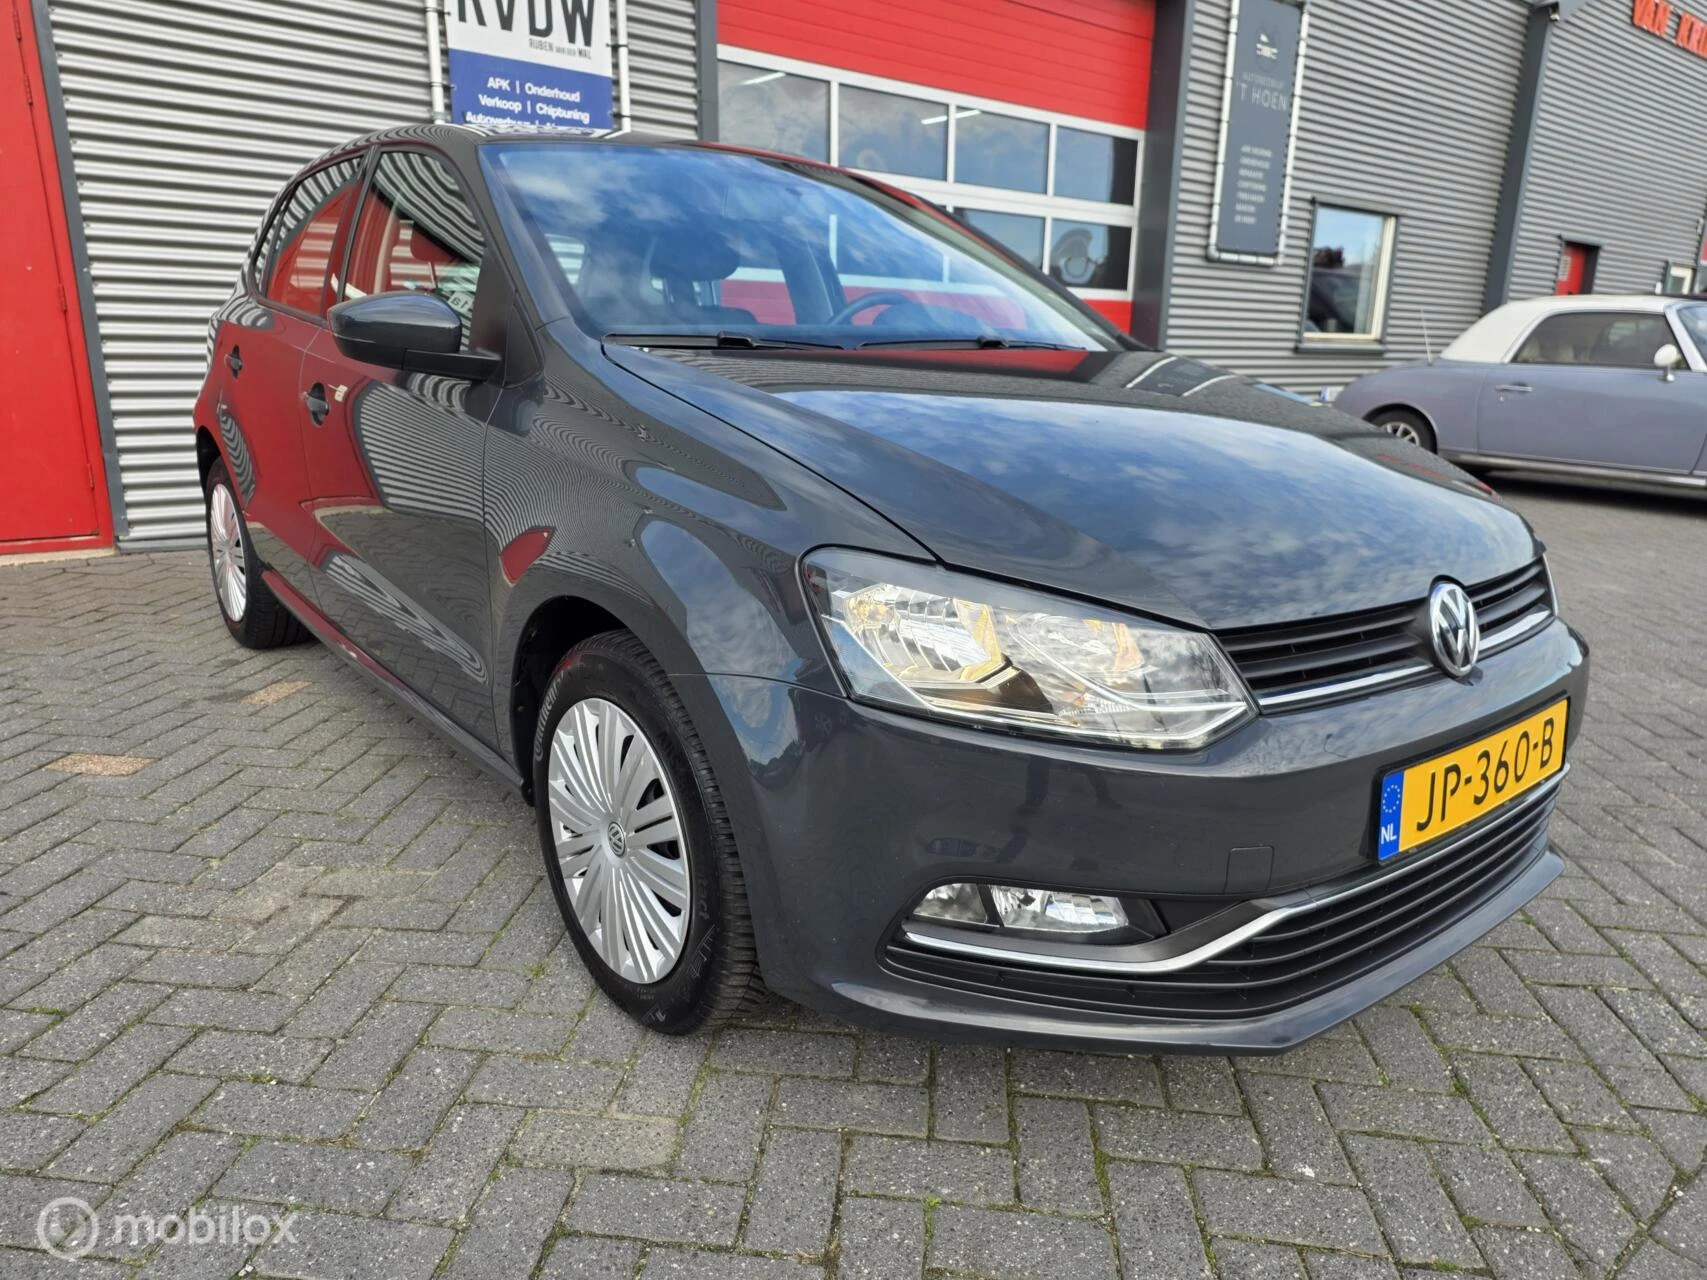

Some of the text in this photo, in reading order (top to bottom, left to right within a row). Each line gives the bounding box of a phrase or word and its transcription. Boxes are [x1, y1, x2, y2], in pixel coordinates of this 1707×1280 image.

[487, 77, 511, 91] APK
[525, 82, 580, 102] Onderhoud
[478, 94, 522, 114] Verkoop
[536, 102, 590, 125] Chiptuning
[1416, 717, 1555, 832] JP-360-B
[1380, 823, 1397, 845] NL
